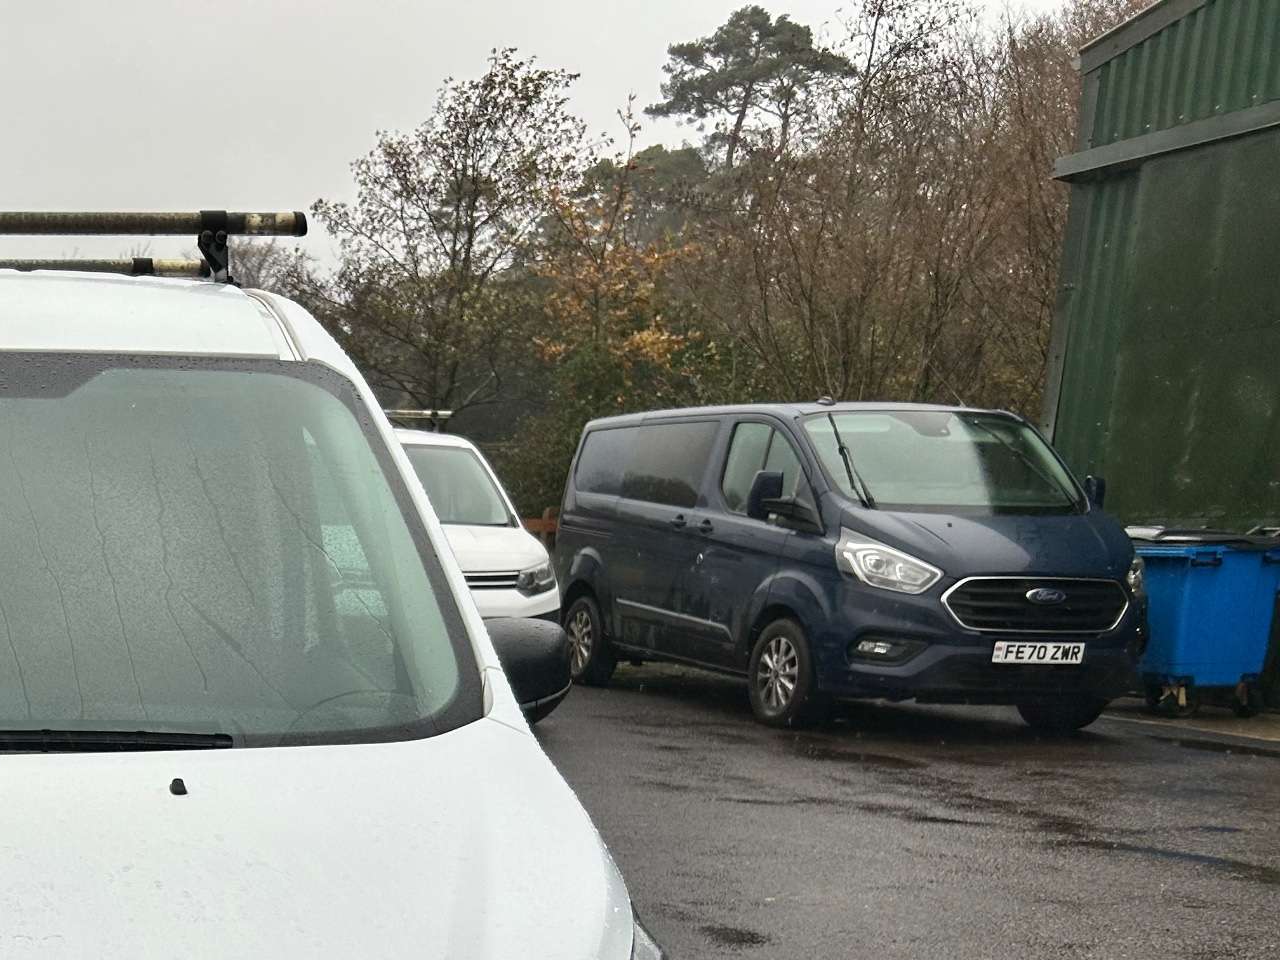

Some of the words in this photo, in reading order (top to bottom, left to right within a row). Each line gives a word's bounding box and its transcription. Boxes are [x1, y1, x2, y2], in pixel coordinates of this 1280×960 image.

[1036, 590, 1059, 601] Ford
[1004, 644, 1047, 660] FE70
[1050, 645, 1081, 661] ZWR
